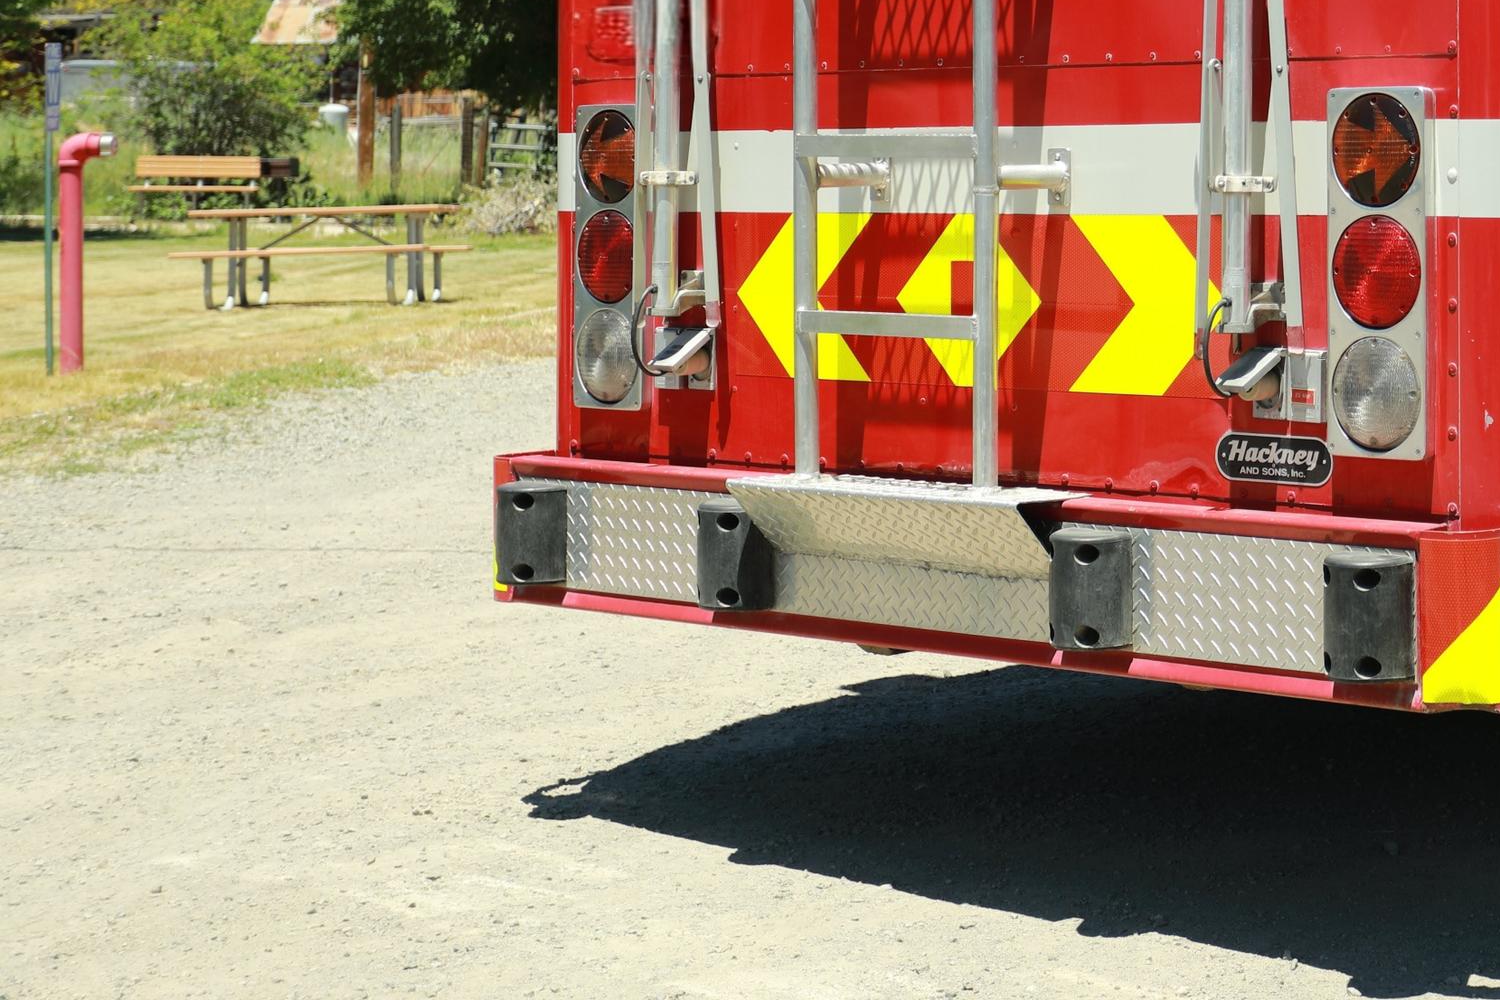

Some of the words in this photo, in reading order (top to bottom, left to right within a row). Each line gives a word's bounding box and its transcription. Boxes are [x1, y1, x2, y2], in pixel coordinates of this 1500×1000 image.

[1228, 439, 1320, 471] Hackney
[1240, 465, 1259, 475] AND
[1262, 467, 1290, 478] SONS,
